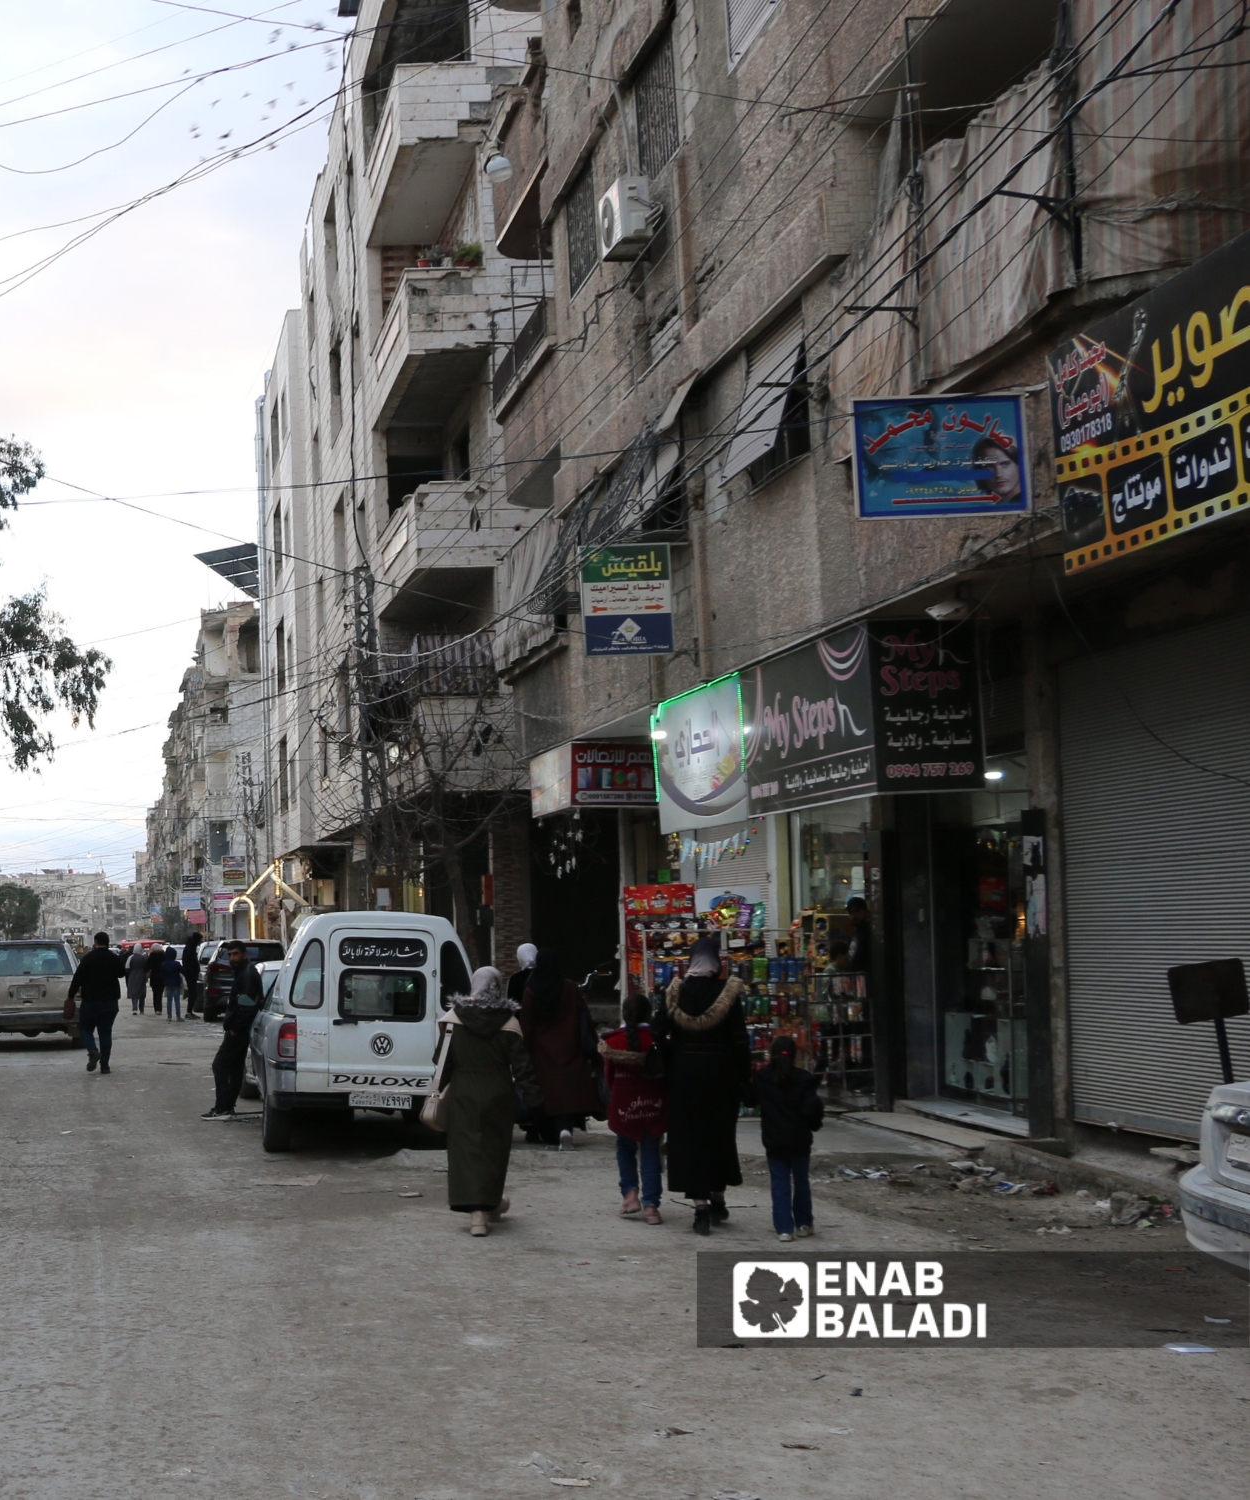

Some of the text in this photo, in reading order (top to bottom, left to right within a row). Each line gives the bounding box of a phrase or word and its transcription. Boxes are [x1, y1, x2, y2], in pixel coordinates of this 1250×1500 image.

[863, 405, 1014, 455] صالون محمد
[1060, 412, 1112, 453] 0930178318
[1174, 437, 1232, 489] ندوات
[601, 550, 662, 577] بلقيس
[880, 628, 937, 668] My
[880, 665, 961, 698] Steps
[763, 691, 837, 759] My Steps
[884, 706, 931, 726] رجالية
[675, 709, 720, 768] الحجازي
[887, 730, 972, 751] نسائية ولادية
[886, 762, 975, 778] 0994 757 269
[364, 945, 376, 957] قوة
[332, 1074, 430, 1087] DULOXE
